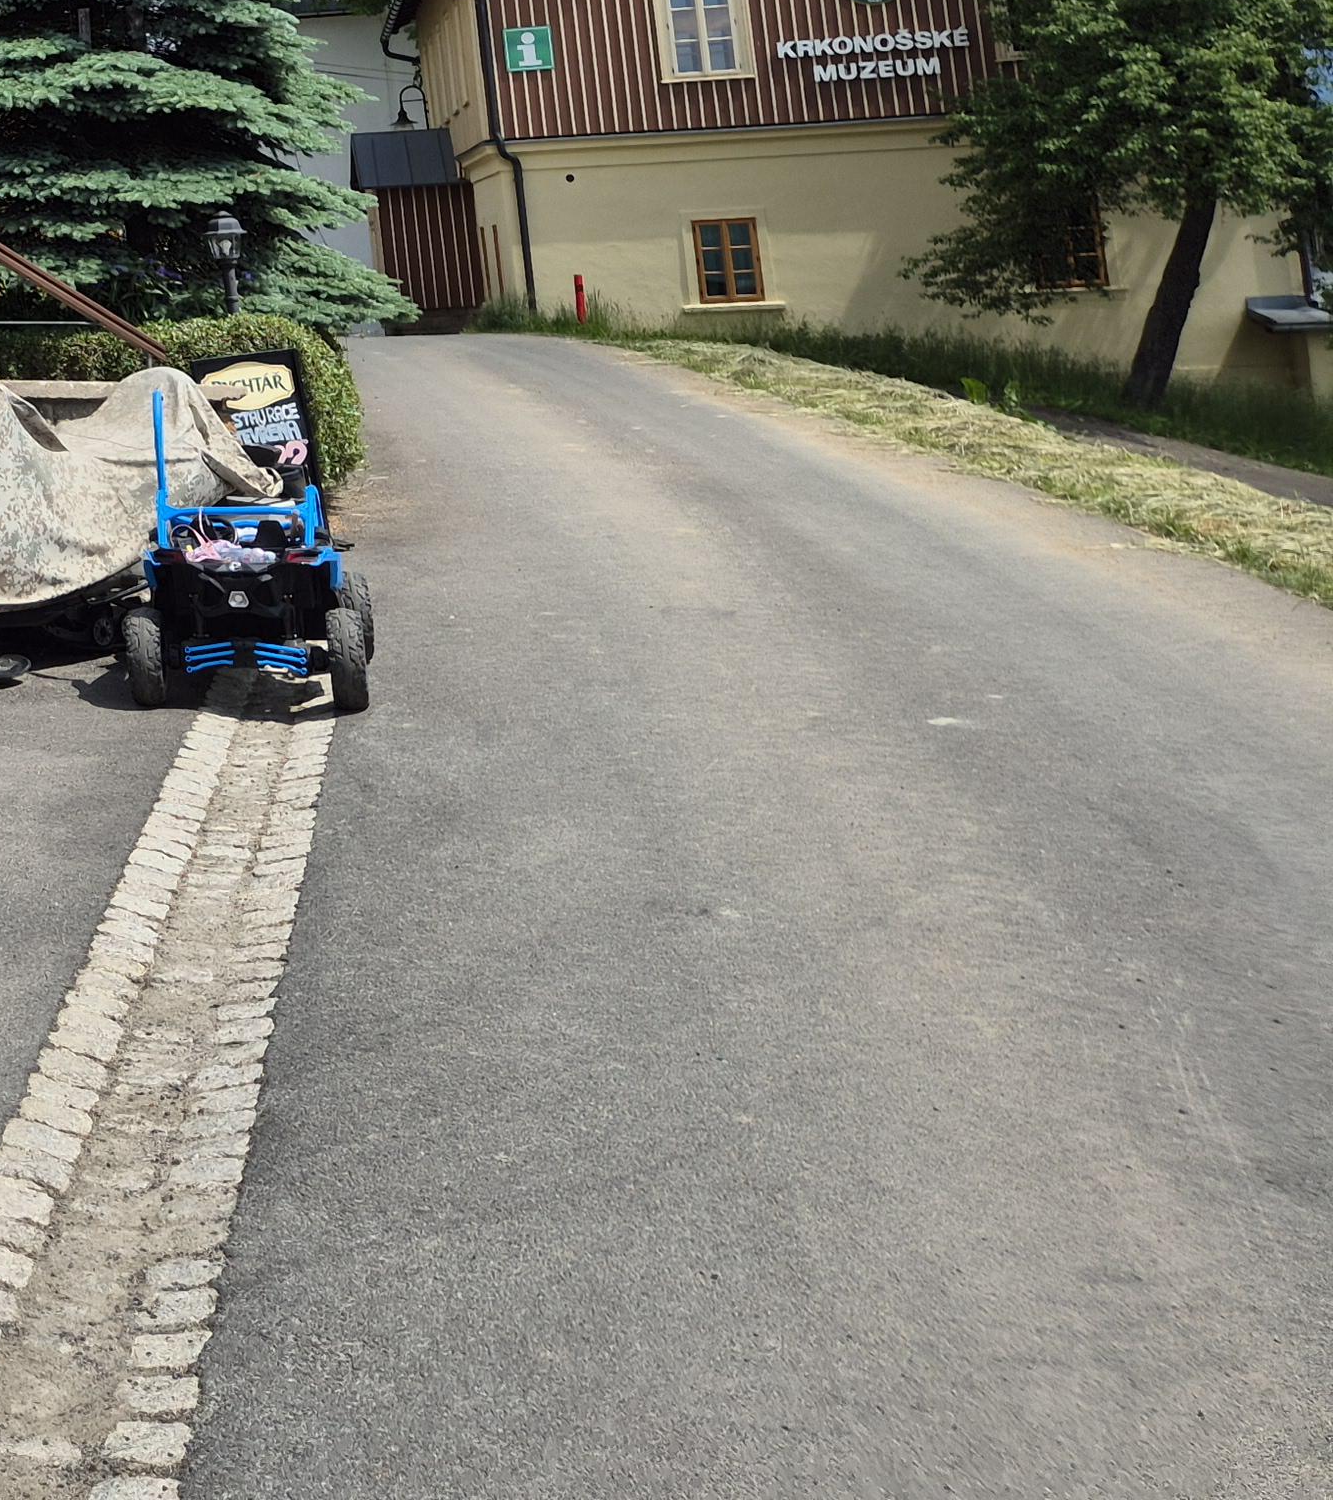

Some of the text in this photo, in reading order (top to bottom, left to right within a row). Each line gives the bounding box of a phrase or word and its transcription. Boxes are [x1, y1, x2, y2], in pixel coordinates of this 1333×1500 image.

[776, 26, 970, 58] KRKONOŠSKÉ
[813, 57, 941, 82] MUZEUM
[211, 372, 288, 394] HTÁŘ
